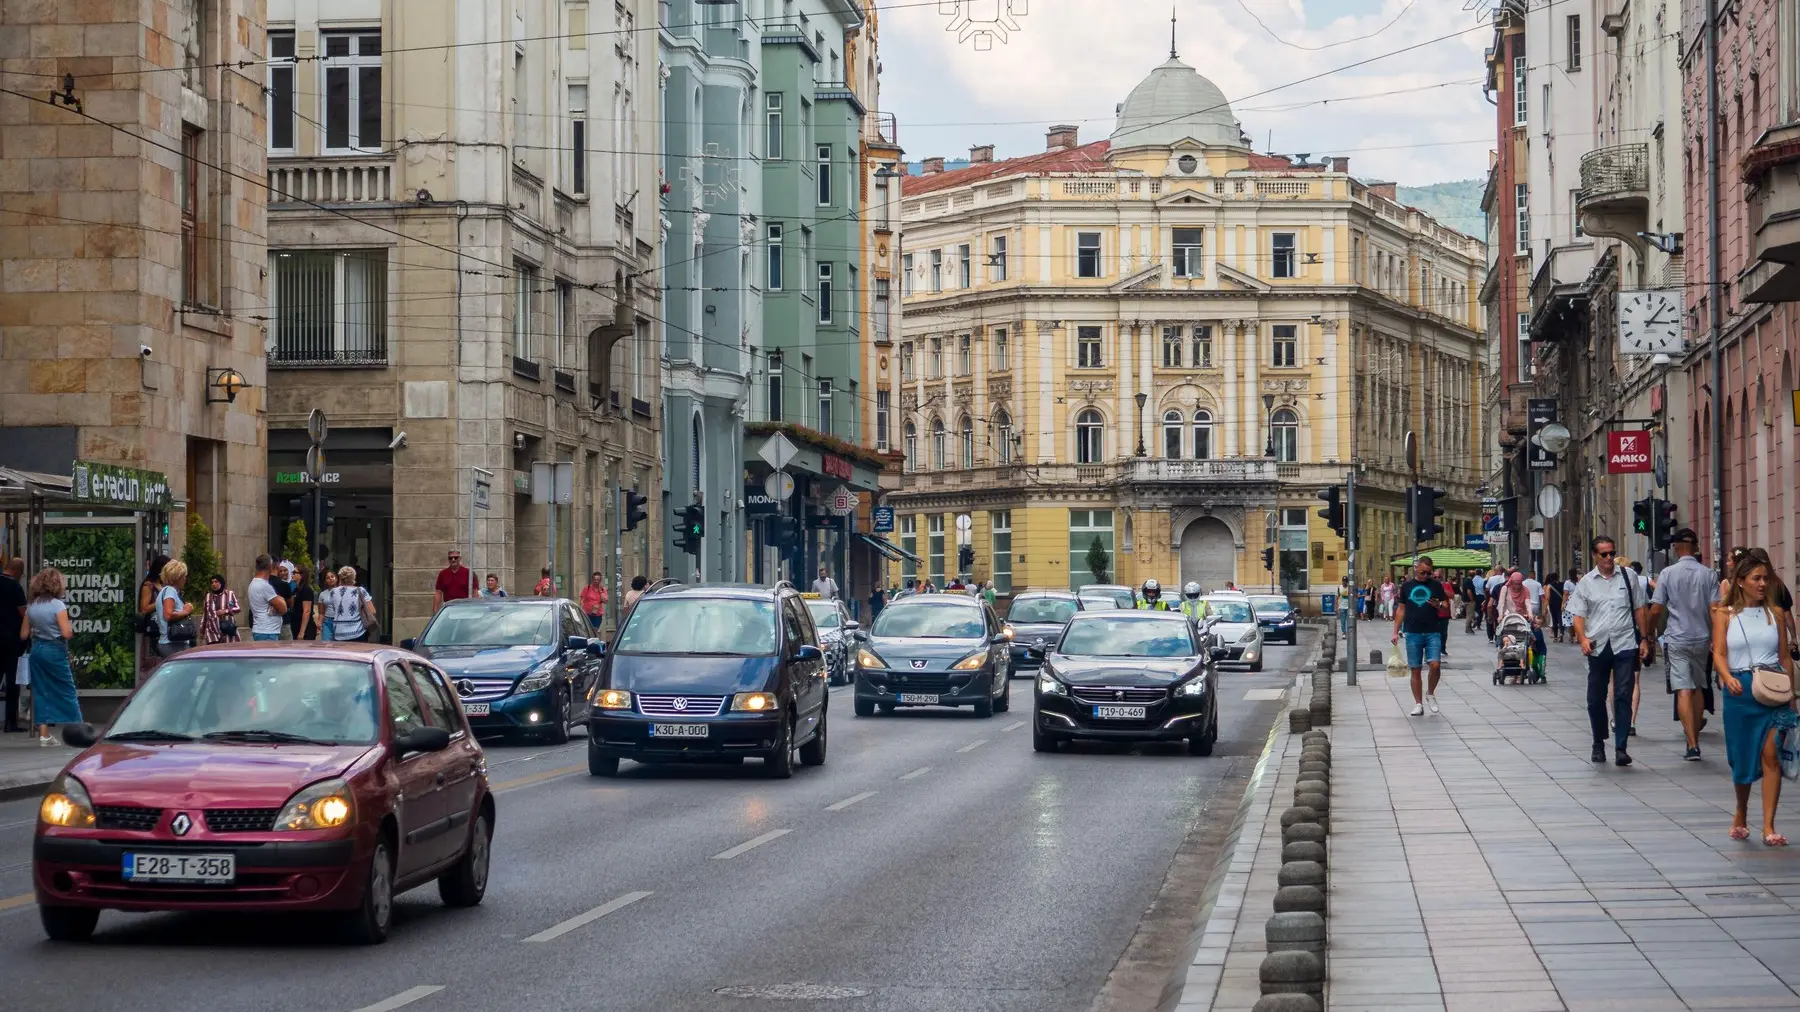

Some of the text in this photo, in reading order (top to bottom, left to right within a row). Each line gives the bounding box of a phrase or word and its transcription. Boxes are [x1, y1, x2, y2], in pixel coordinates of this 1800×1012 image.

[1611, 454, 1648, 463] AMKO
[92, 469, 139, 502] e-račun
[64, 574, 120, 588] TIVIRAJ
[65, 586, 124, 603] KTRIČNI
[71, 619, 111, 633] KIRAJ
[464, 704, 488, 713] T-337
[136, 857, 231, 876] E28-T-358
